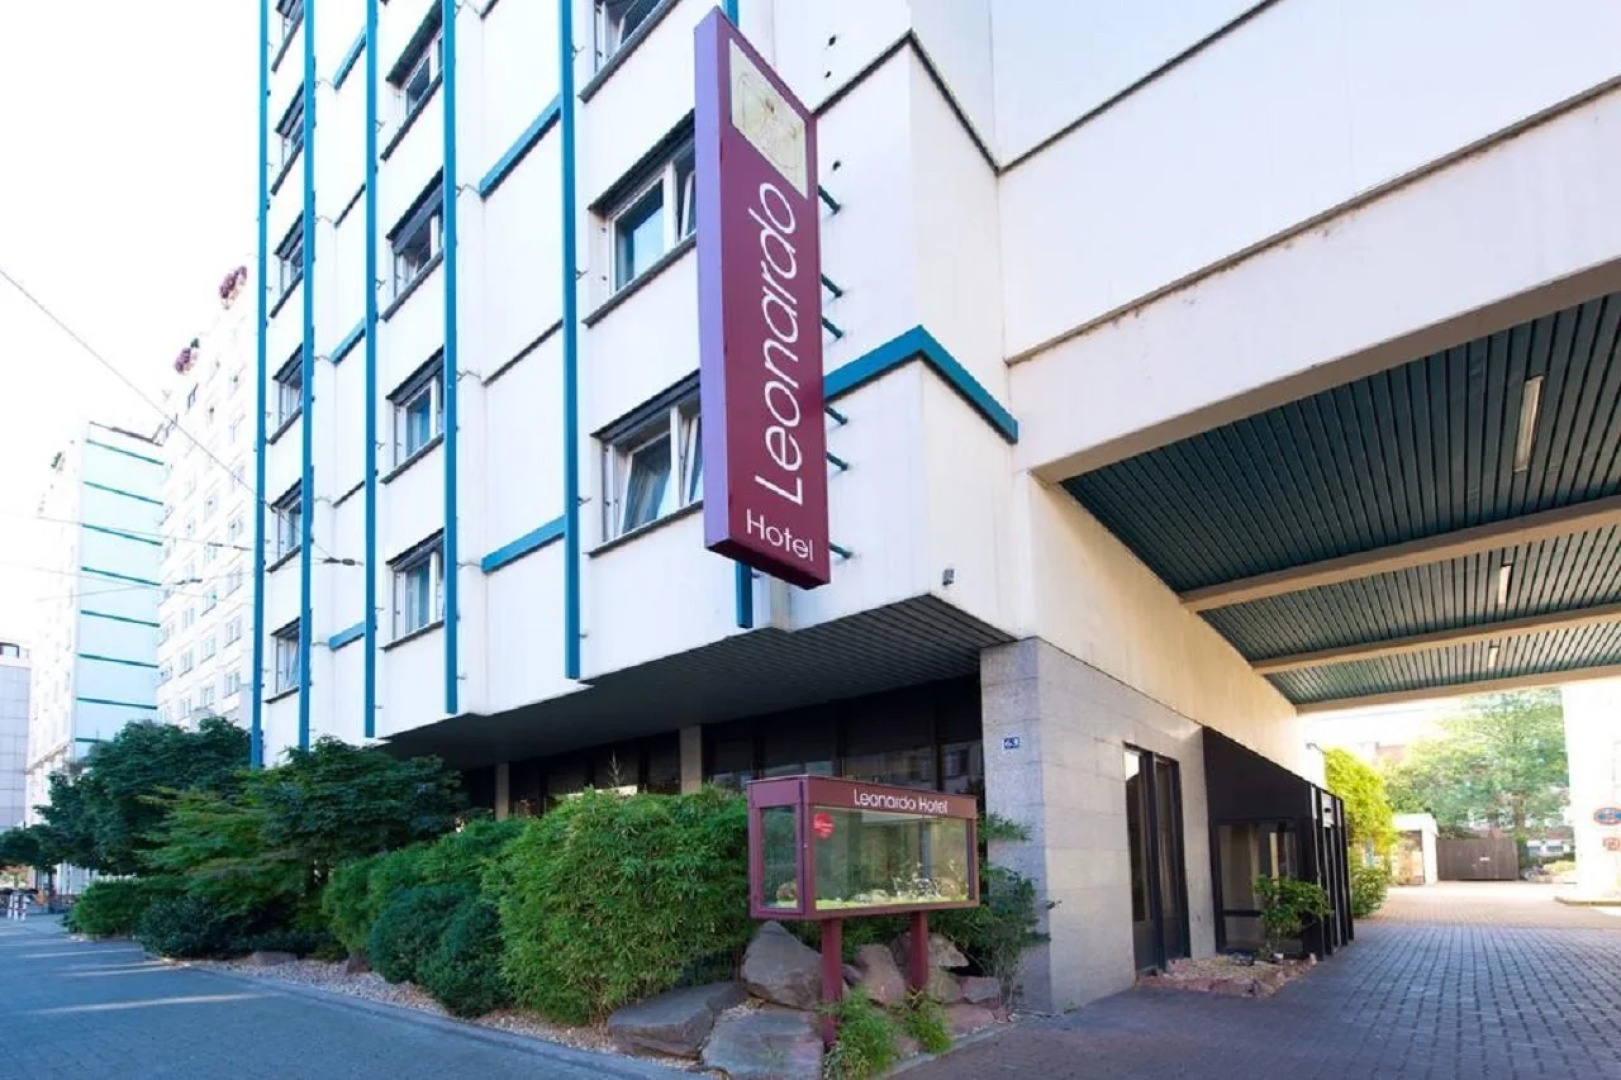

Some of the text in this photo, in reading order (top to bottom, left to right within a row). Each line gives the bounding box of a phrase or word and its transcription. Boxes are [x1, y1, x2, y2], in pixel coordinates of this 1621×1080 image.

[748, 182, 802, 506] Leonardo
[746, 508, 814, 562] Hotel
[853, 788, 948, 815] Leonardo Hotel
